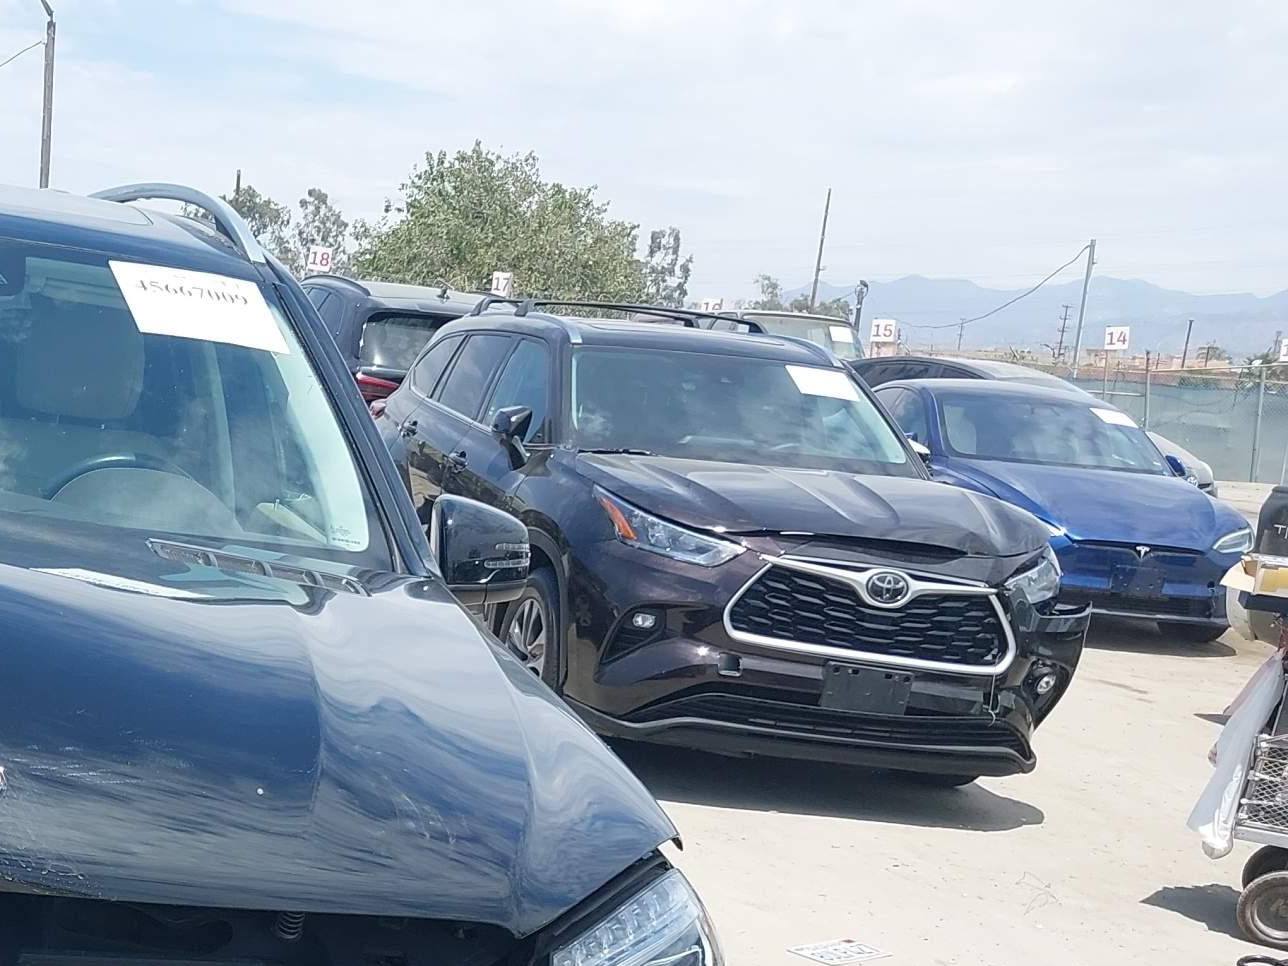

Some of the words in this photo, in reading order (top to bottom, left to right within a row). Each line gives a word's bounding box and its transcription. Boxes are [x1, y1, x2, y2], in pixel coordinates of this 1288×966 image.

[310, 251, 329, 267] 18
[493, 277, 510, 292] 17
[872, 324, 893, 338] 15
[1107, 330, 1128, 345] 14
